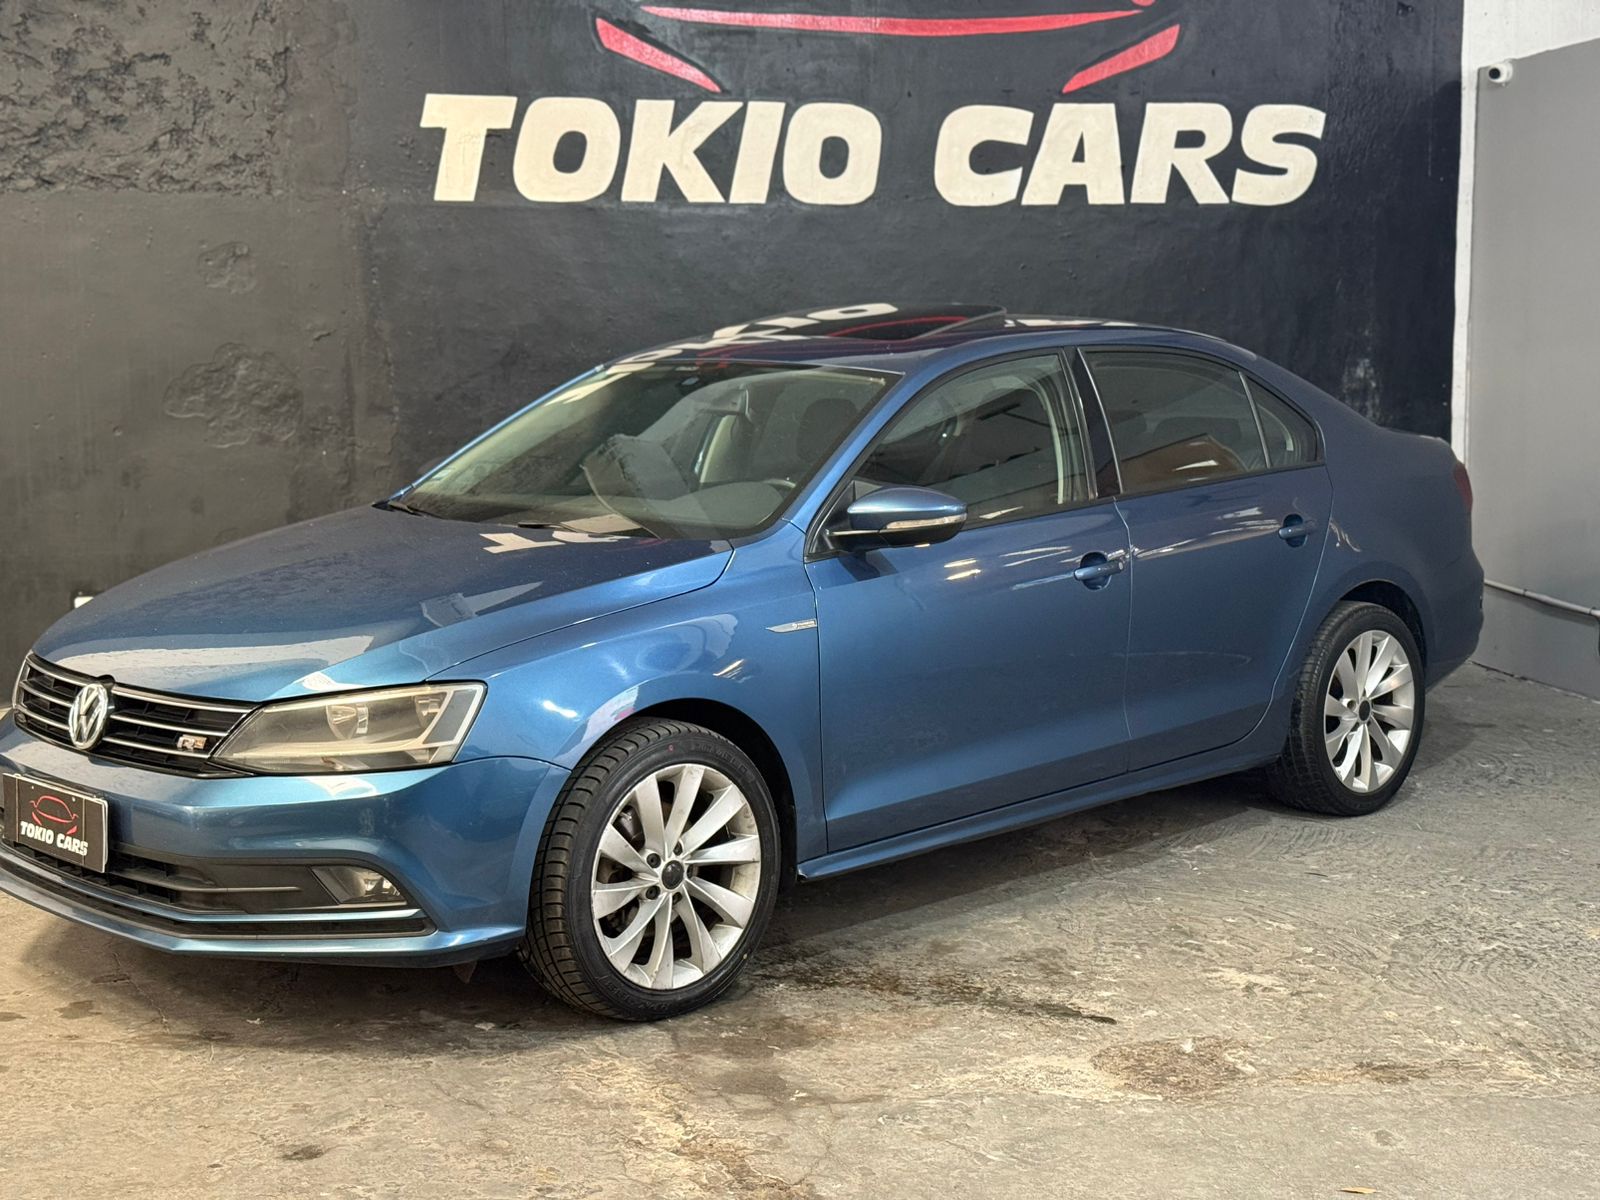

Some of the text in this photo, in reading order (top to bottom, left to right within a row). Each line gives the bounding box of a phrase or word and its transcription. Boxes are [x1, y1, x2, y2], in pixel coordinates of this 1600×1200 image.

[420, 93, 1326, 206] TOKIO CARS
[20, 820, 89, 856] TOKIO CARS
